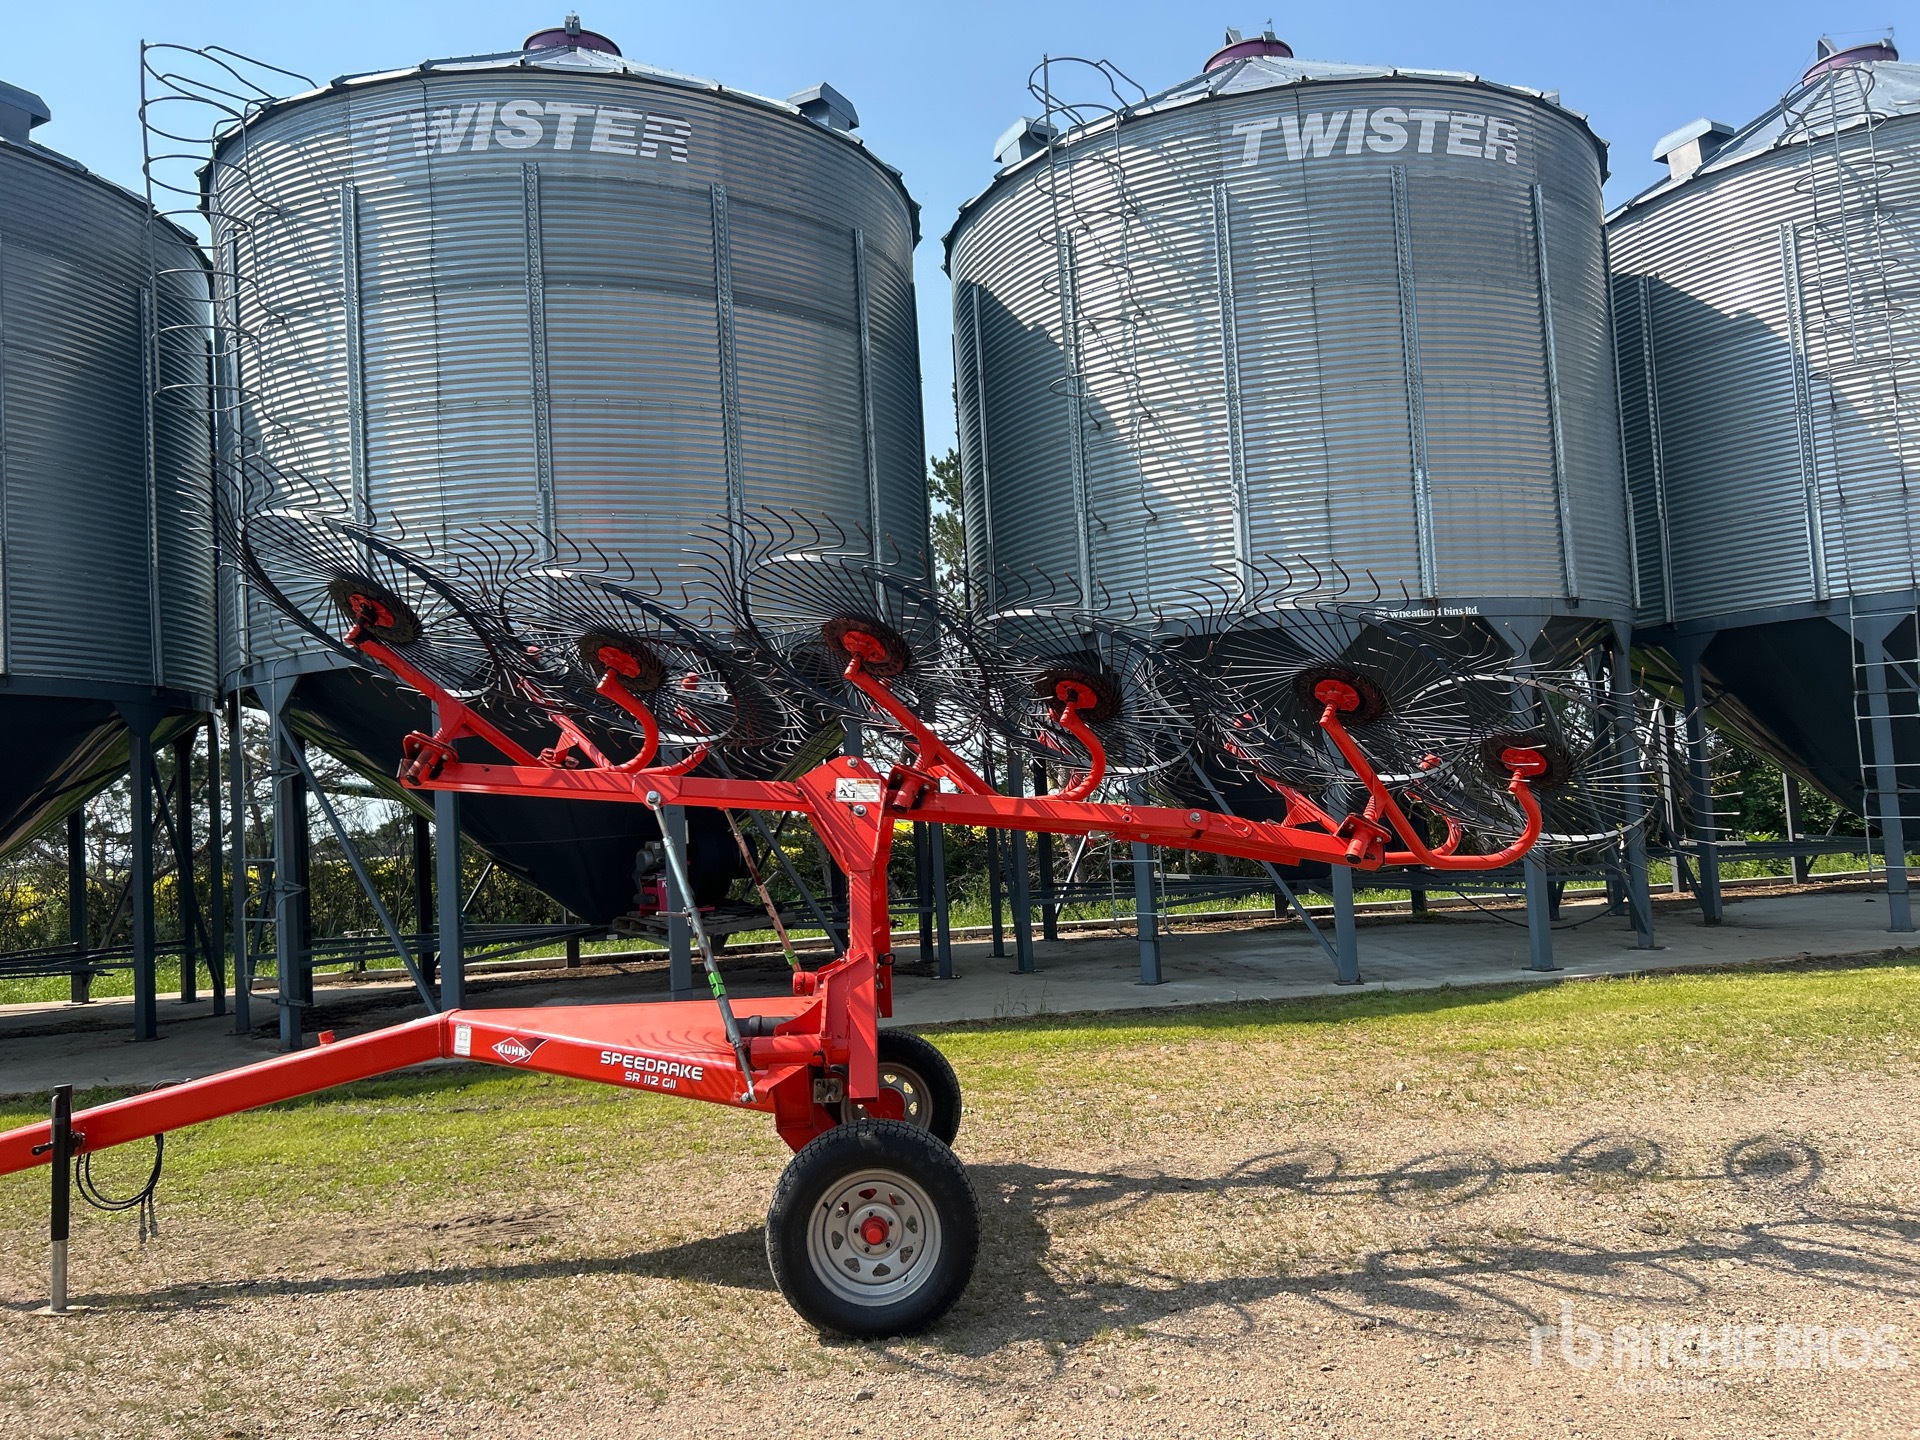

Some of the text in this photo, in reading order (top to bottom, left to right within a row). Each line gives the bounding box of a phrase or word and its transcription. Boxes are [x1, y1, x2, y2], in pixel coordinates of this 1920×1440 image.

[362, 99, 693, 163] TWISTER
[1232, 107, 1519, 166] TWISTER
[1443, 606, 1464, 616] bins
[497, 1043, 527, 1057] KUHN
[600, 1050, 704, 1081] SPEEDRAKE
[624, 1071, 641, 1083] SR
